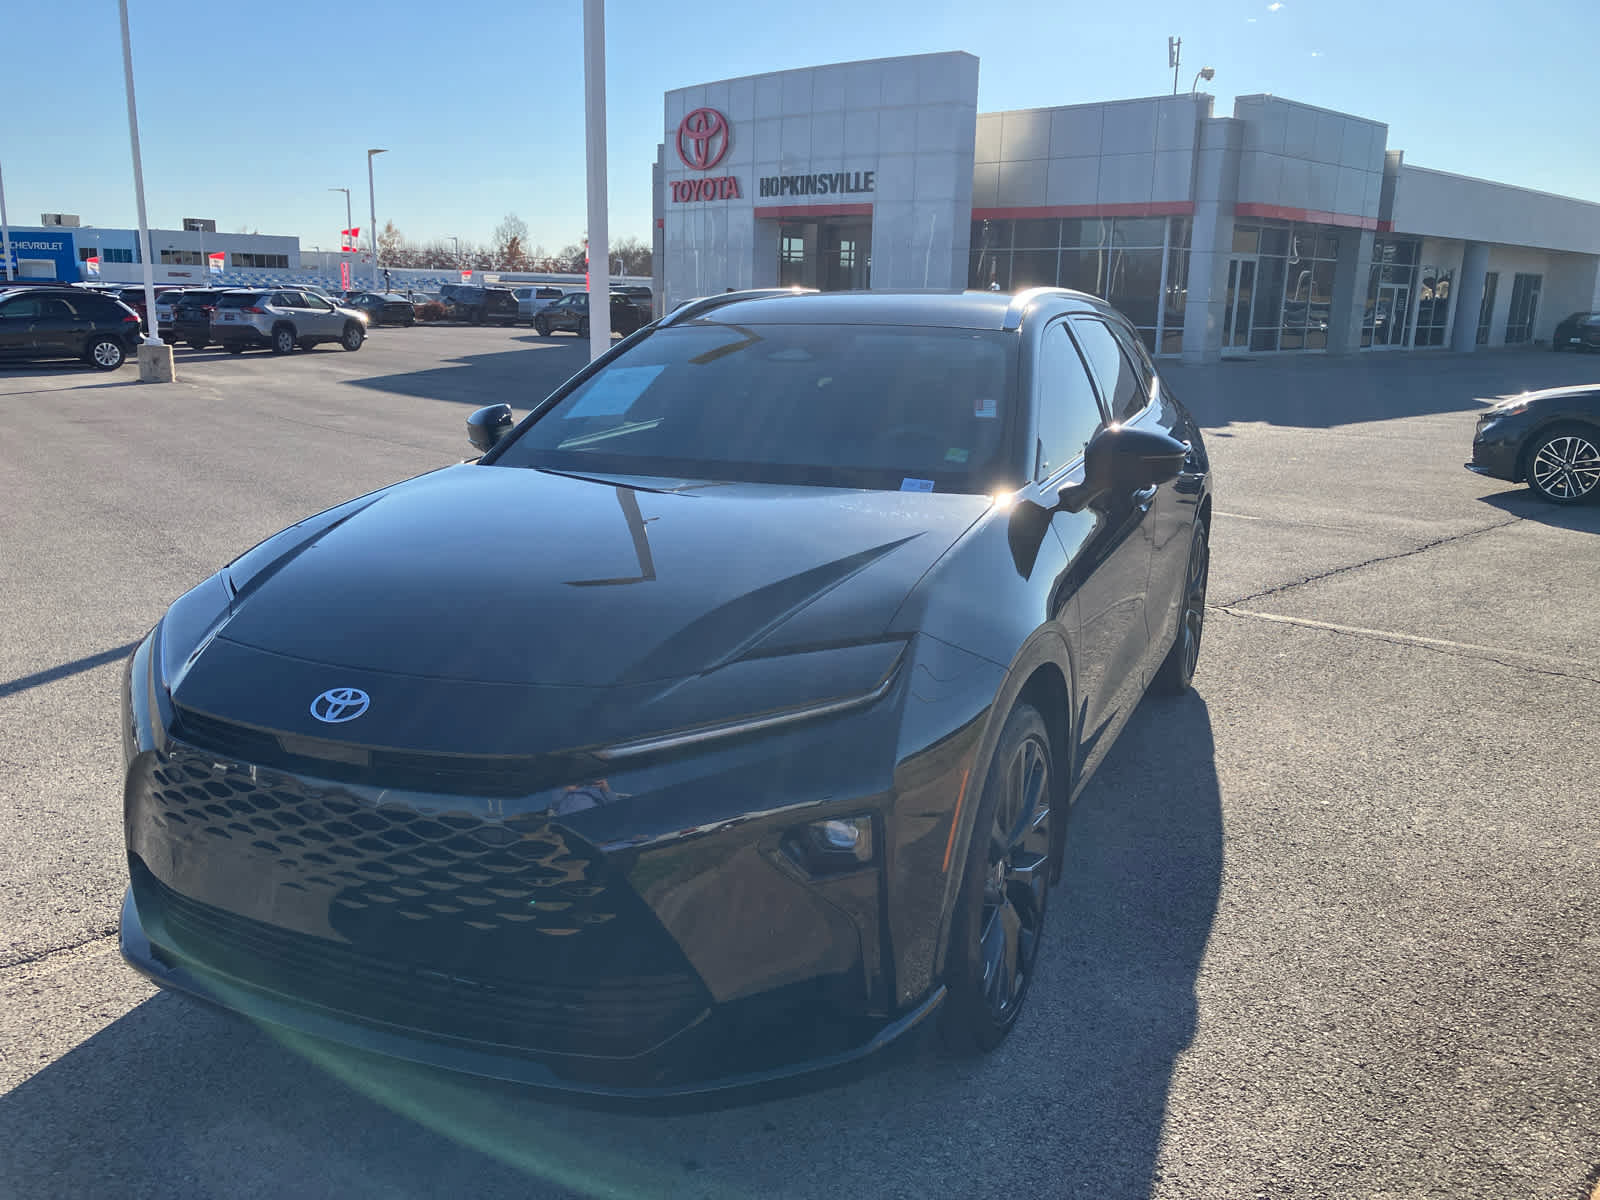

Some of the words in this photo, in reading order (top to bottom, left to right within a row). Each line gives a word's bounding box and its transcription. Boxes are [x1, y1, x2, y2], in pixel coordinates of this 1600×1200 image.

[670, 176, 740, 203] TOYOTA
[760, 171, 874, 197] HOPKINSVILLE
[10, 241, 64, 250] CHEVROLET
